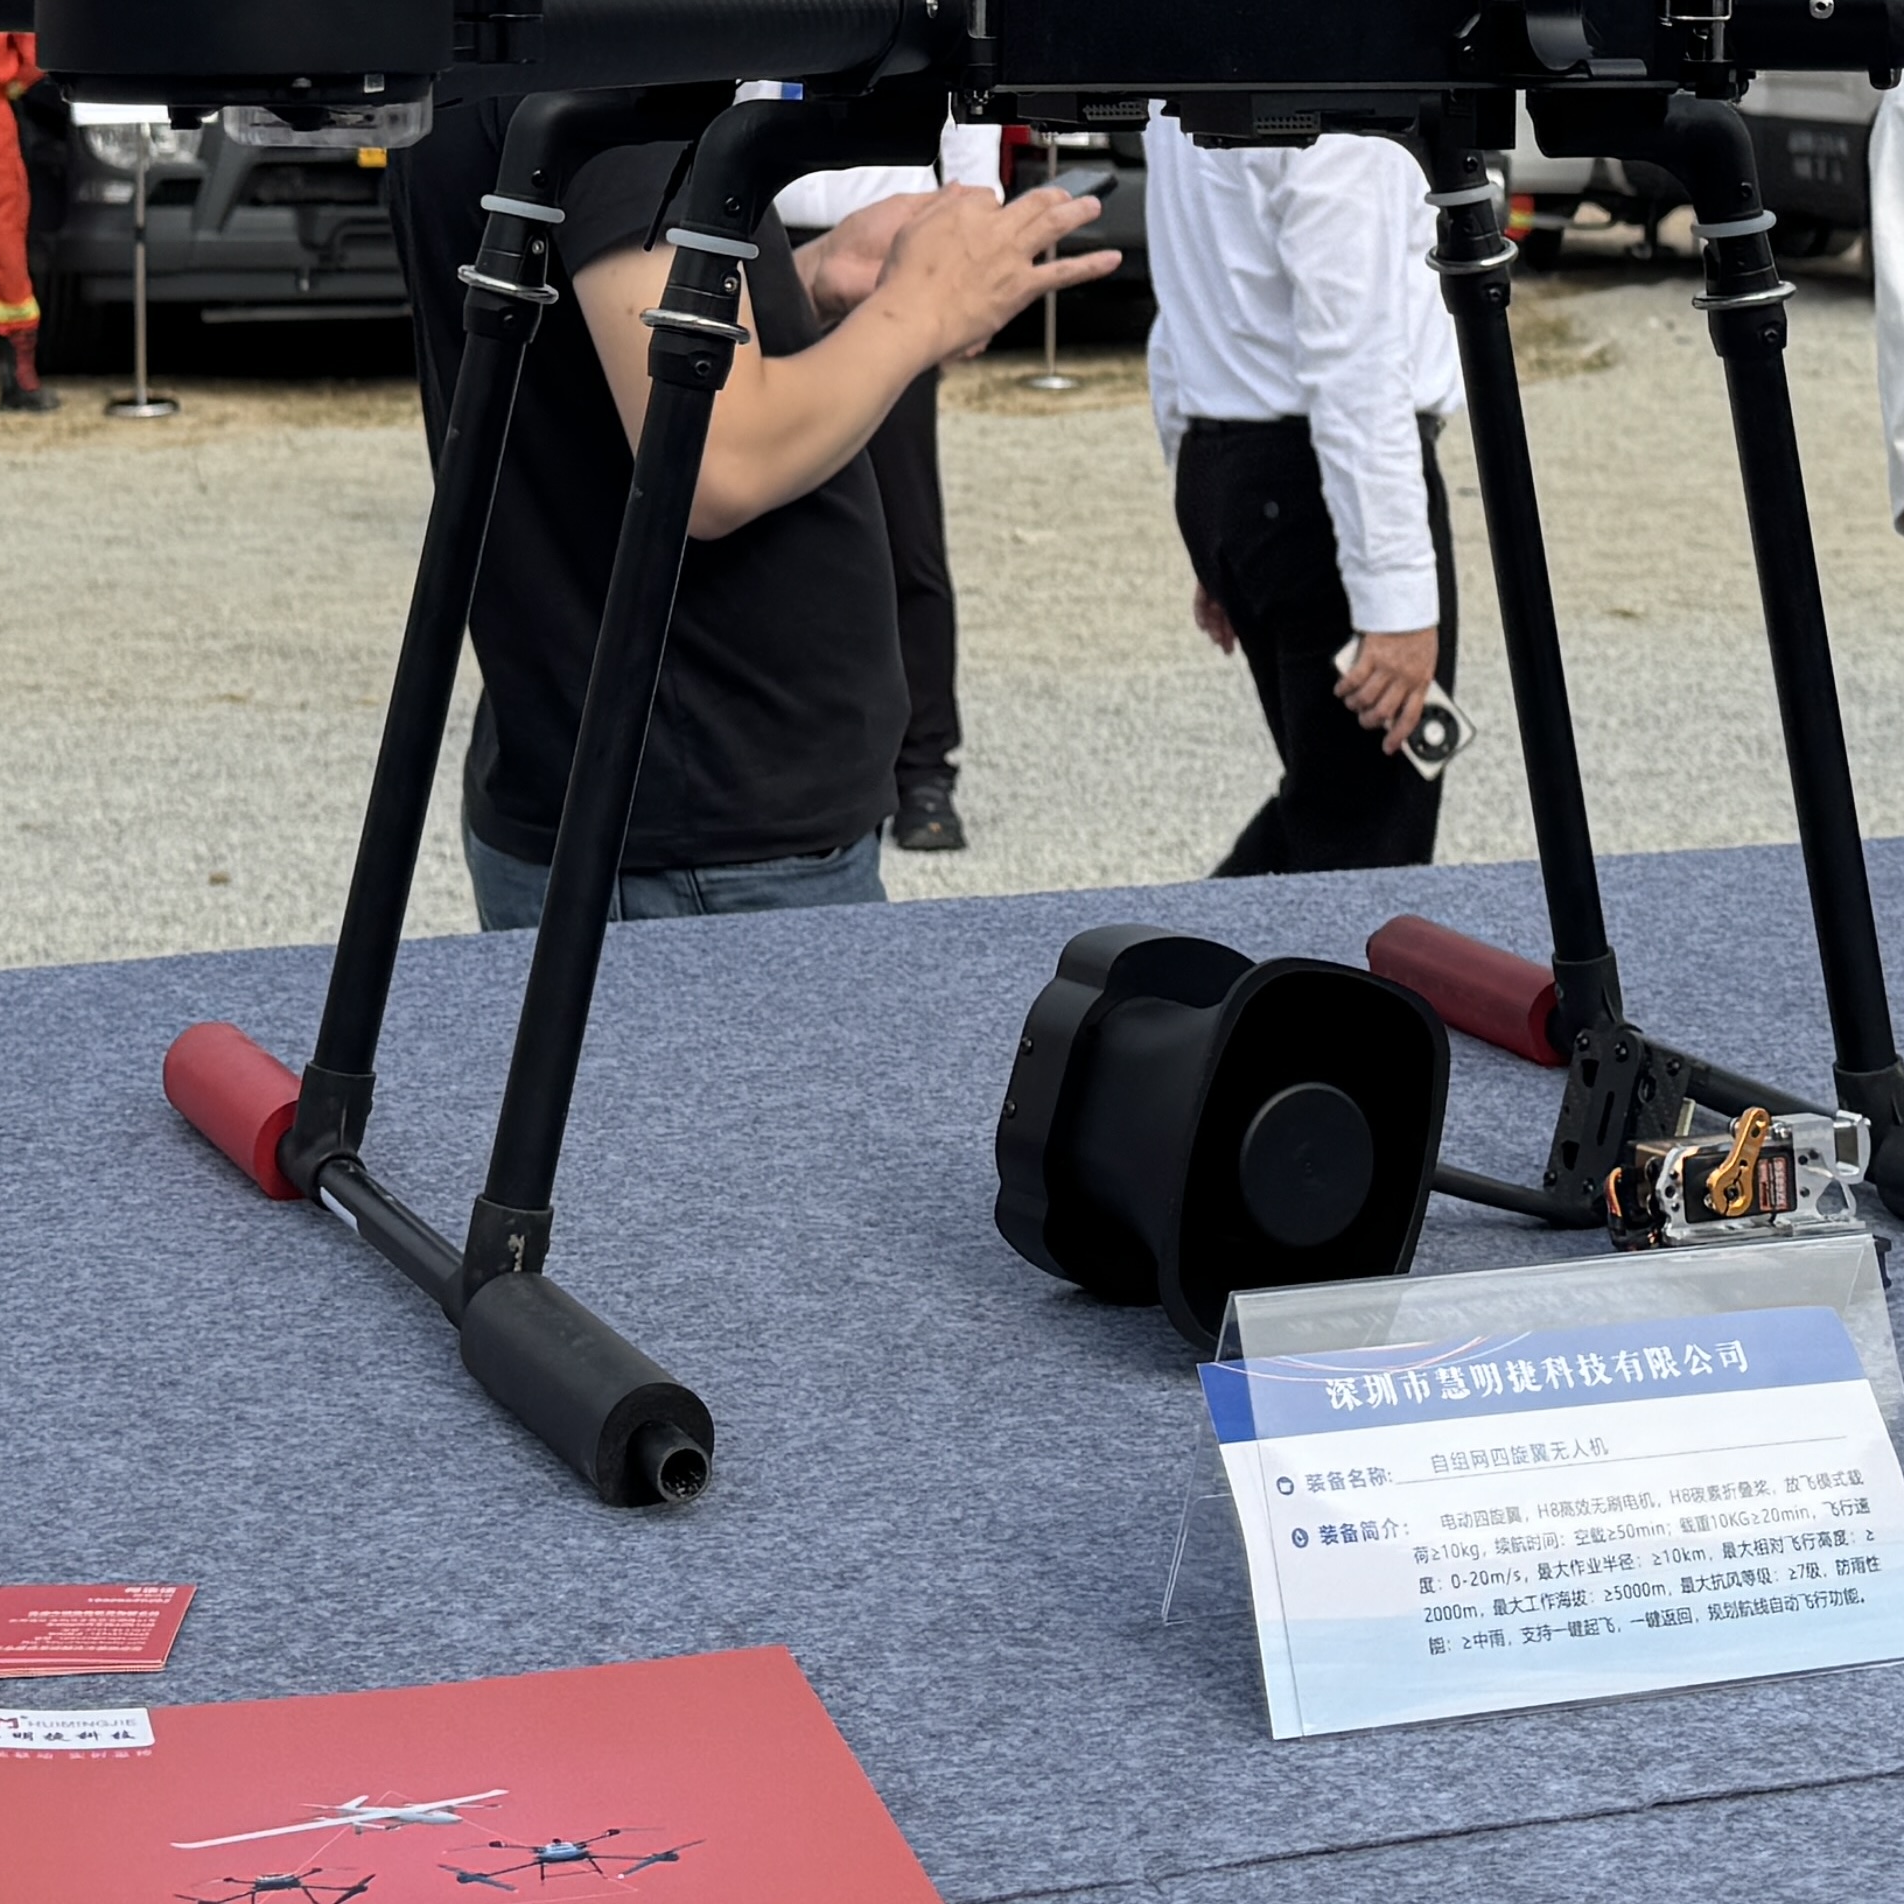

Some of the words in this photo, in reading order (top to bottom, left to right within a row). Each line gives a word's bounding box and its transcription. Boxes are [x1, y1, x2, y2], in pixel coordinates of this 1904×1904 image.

[1324, 1339, 1749, 1412] 深圳市慧明捷科技有限公司
[1430, 1437, 1610, 1474] 自组网四旋翼无人机
